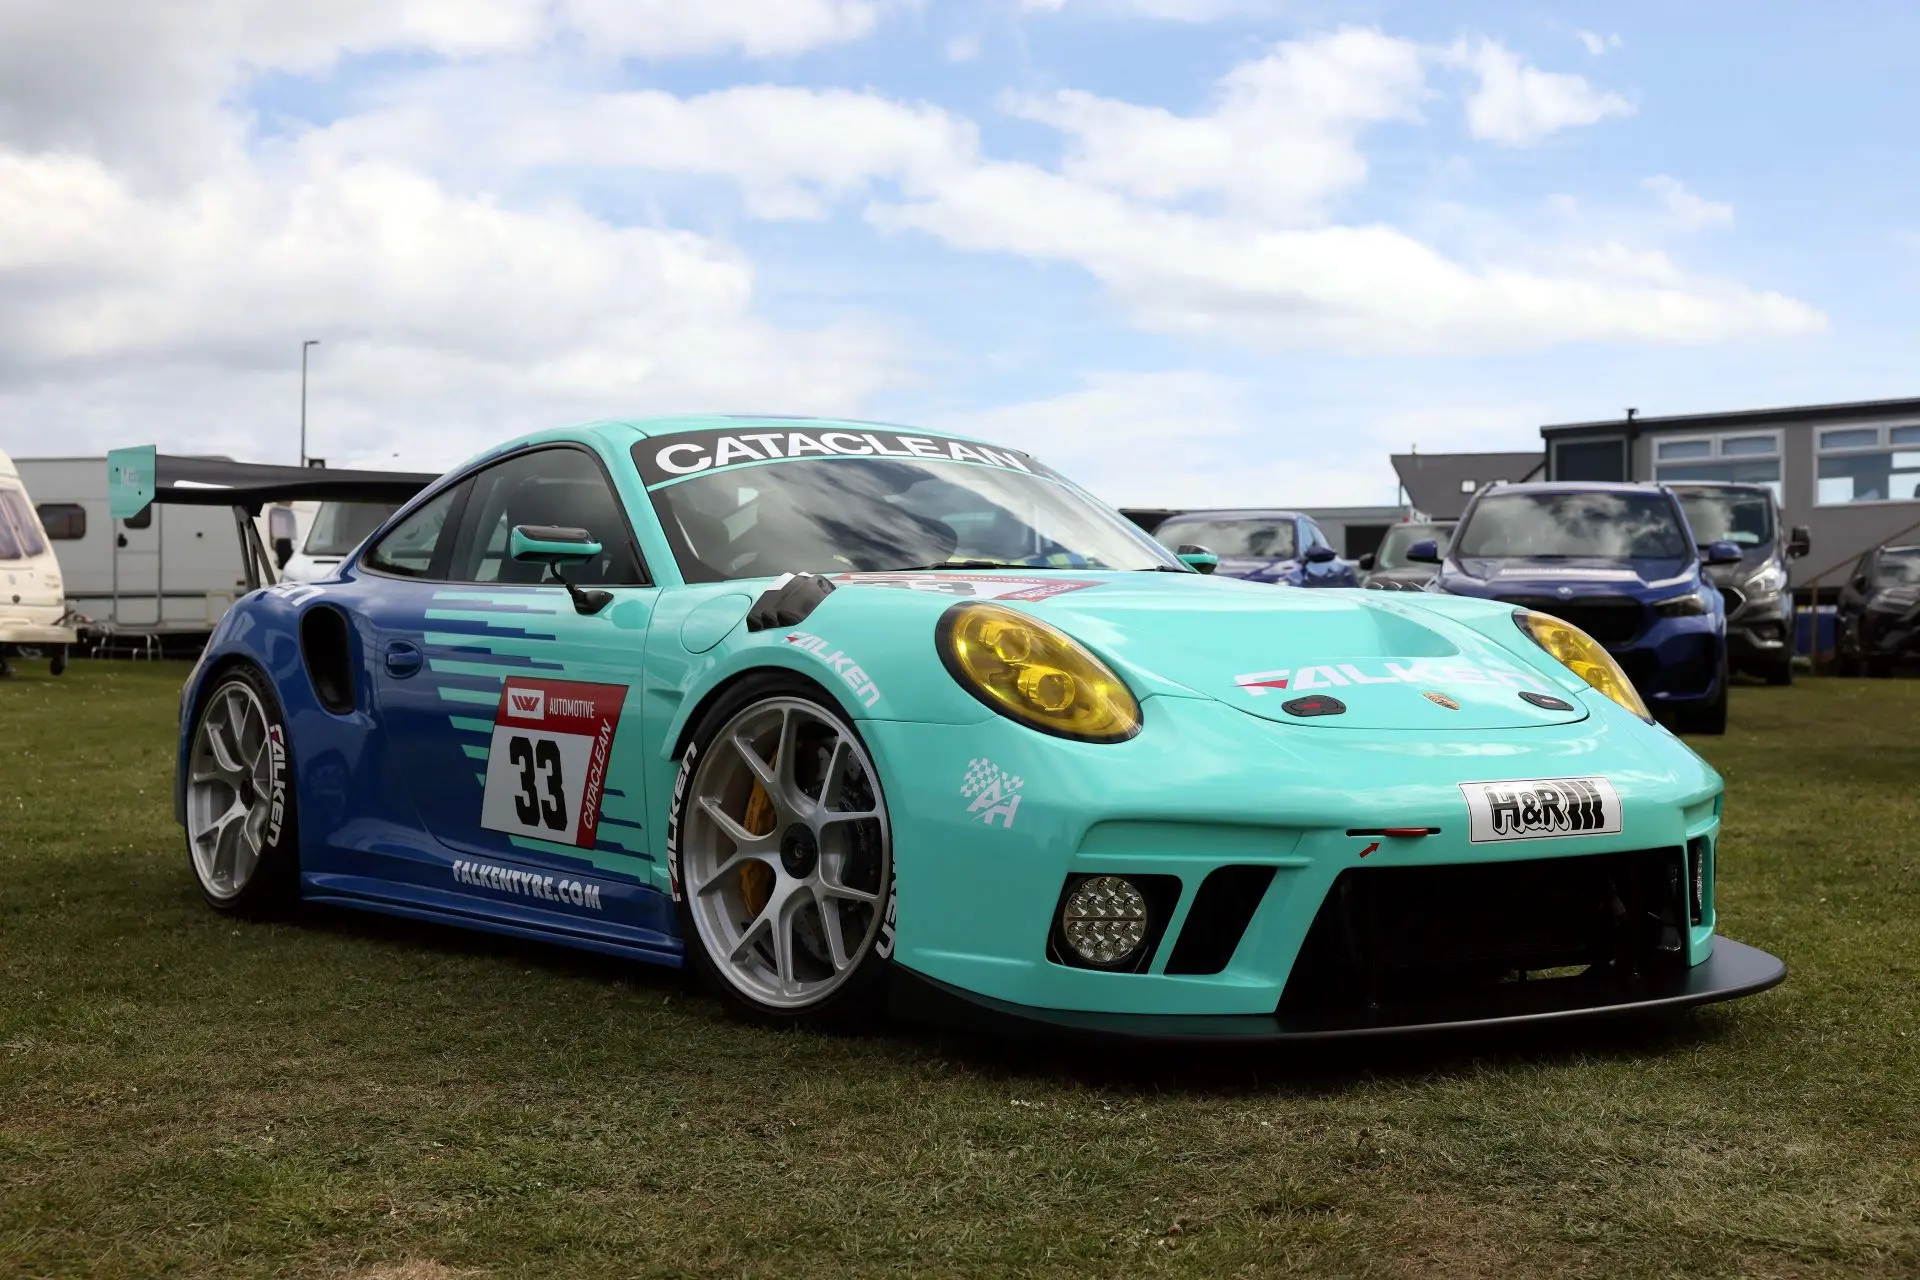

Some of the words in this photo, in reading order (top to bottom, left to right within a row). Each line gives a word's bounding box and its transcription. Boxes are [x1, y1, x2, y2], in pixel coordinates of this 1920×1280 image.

[655, 432, 1031, 475] CATACLEAN
[781, 630, 880, 709] FALKEN
[1232, 662, 1552, 698] FALKEN
[549, 697, 595, 719] AUTOMOTIVE
[269, 723, 286, 848] FALKEN
[509, 735, 568, 832] 33
[583, 718, 612, 830] CATACLEAN
[667, 741, 698, 902] FALKEN
[1484, 783, 1572, 835] H&R
[452, 860, 602, 911] FALKENTYRE.COM
